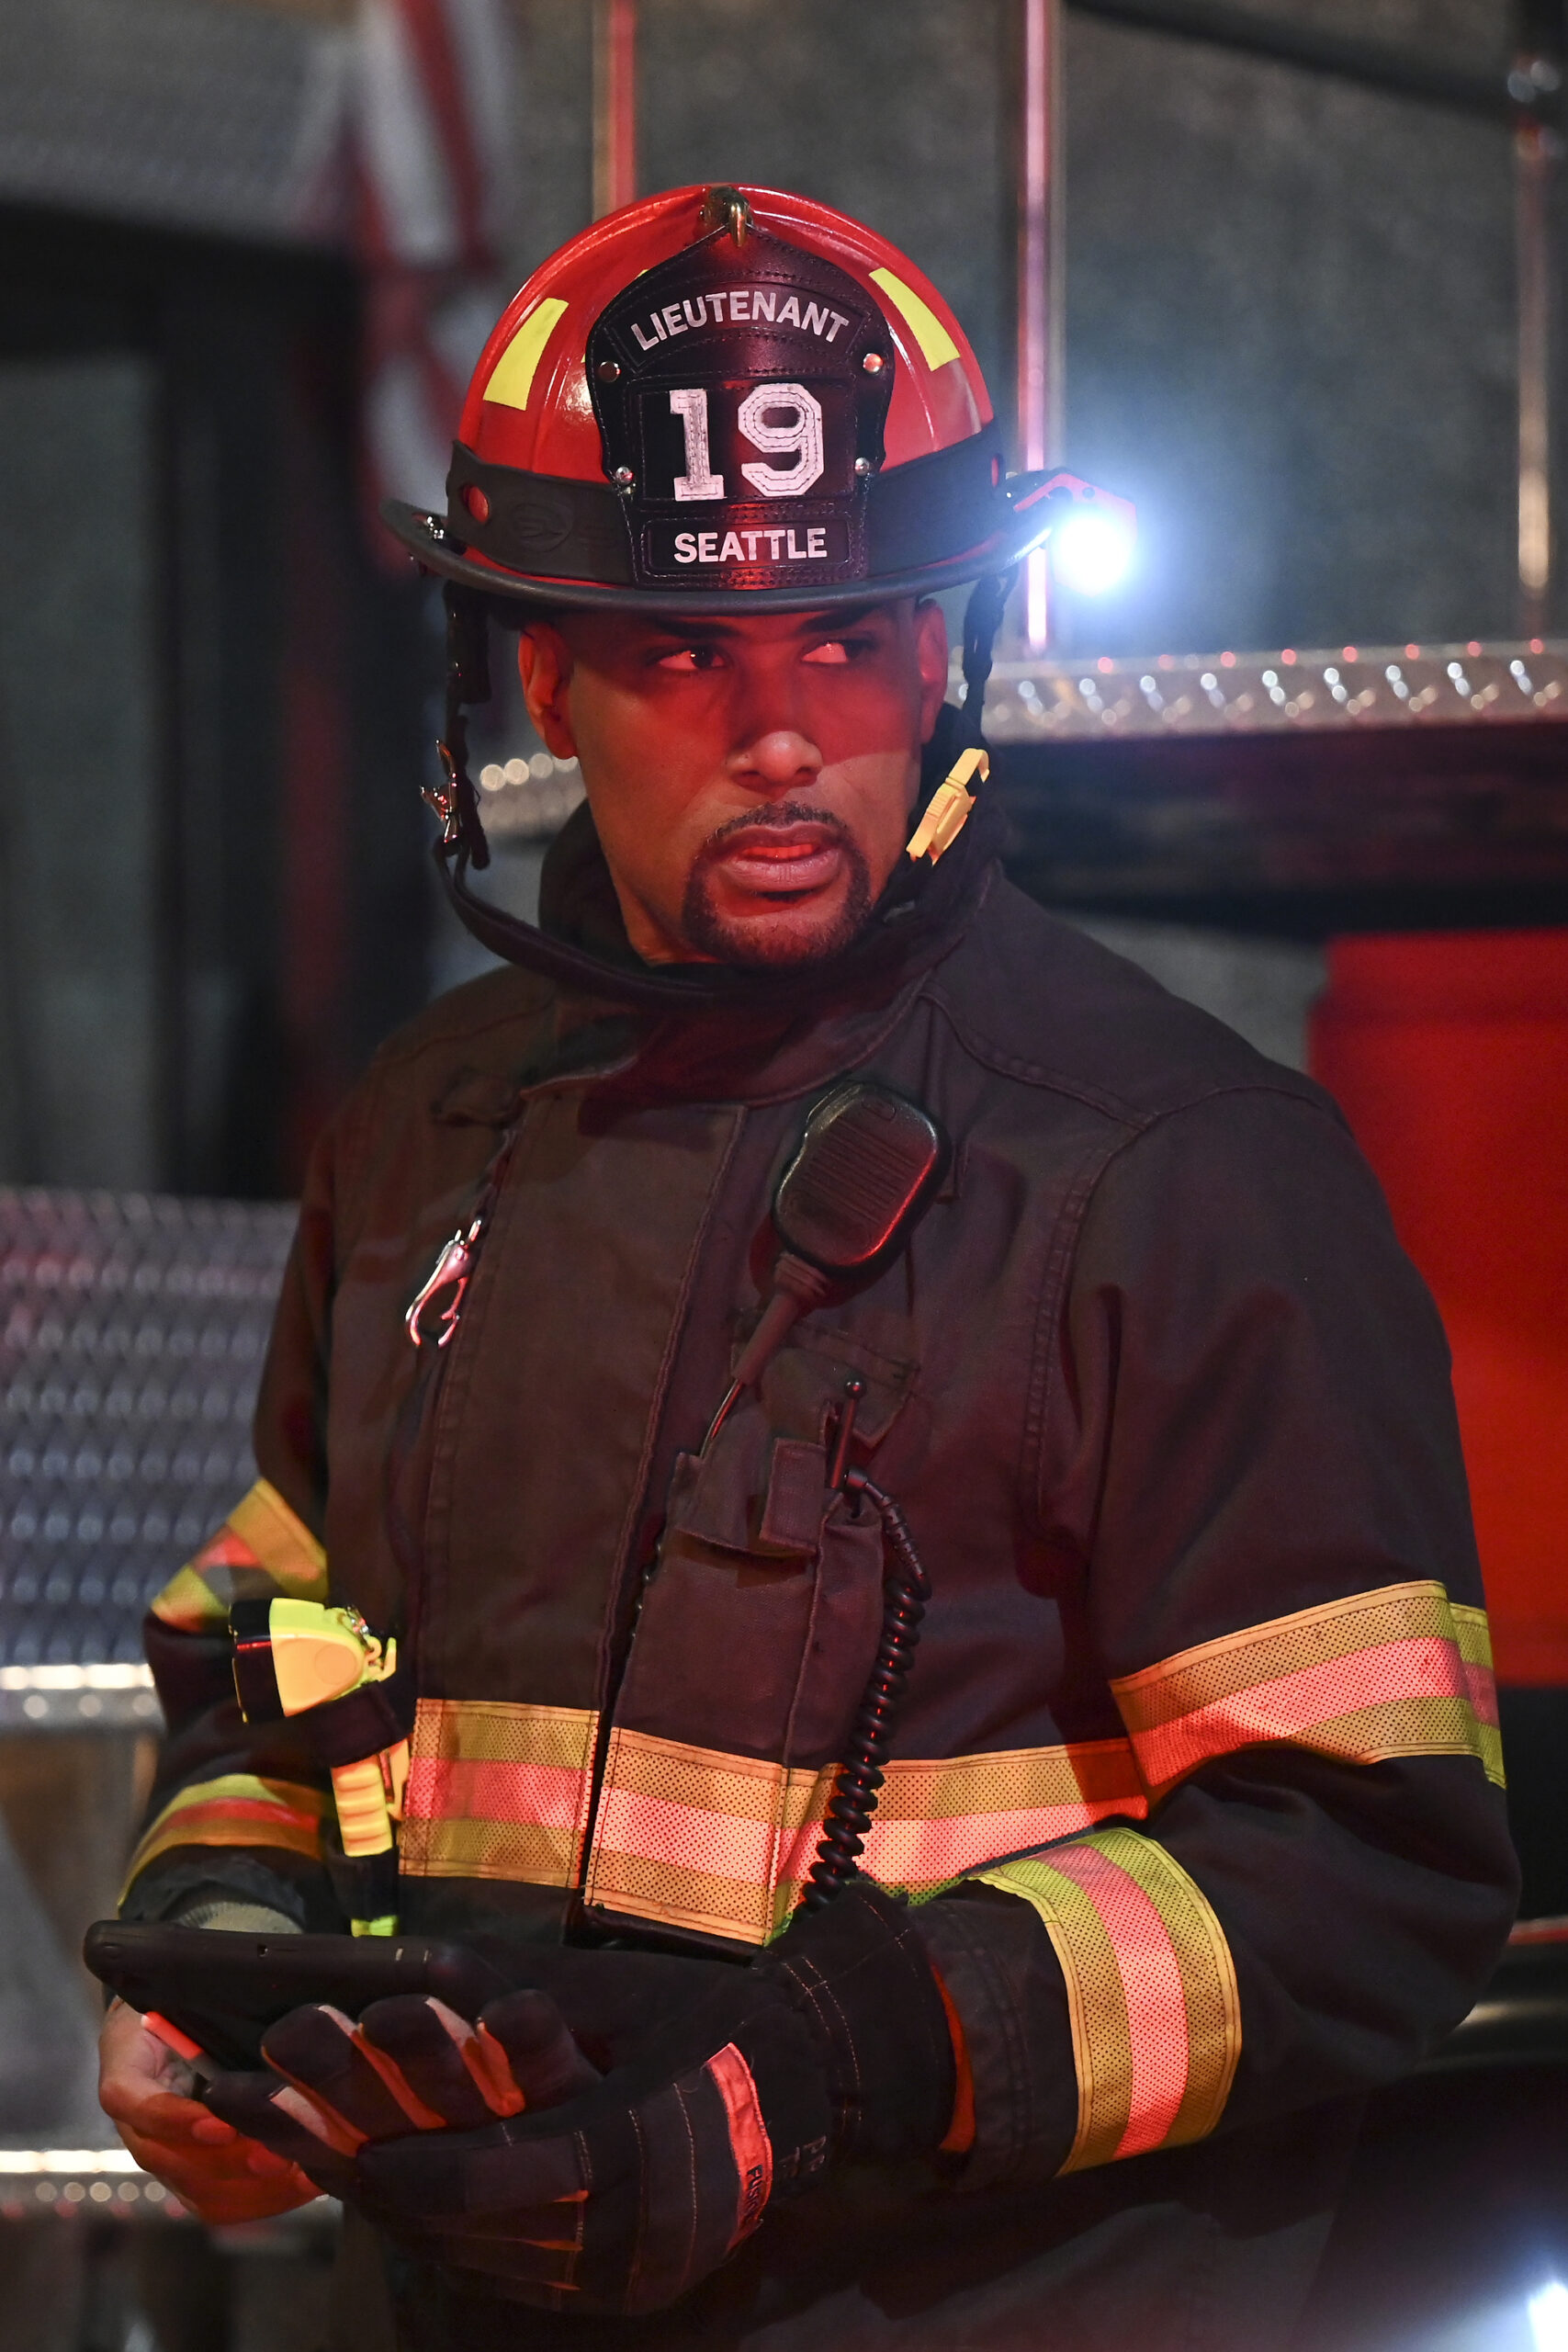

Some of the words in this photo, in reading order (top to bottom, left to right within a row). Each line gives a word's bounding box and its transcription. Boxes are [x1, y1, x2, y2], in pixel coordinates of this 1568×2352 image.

[630, 290, 850, 351] LIEUTENANT
[670, 382, 826, 502] 19
[673, 527, 828, 563] SEATTLE
